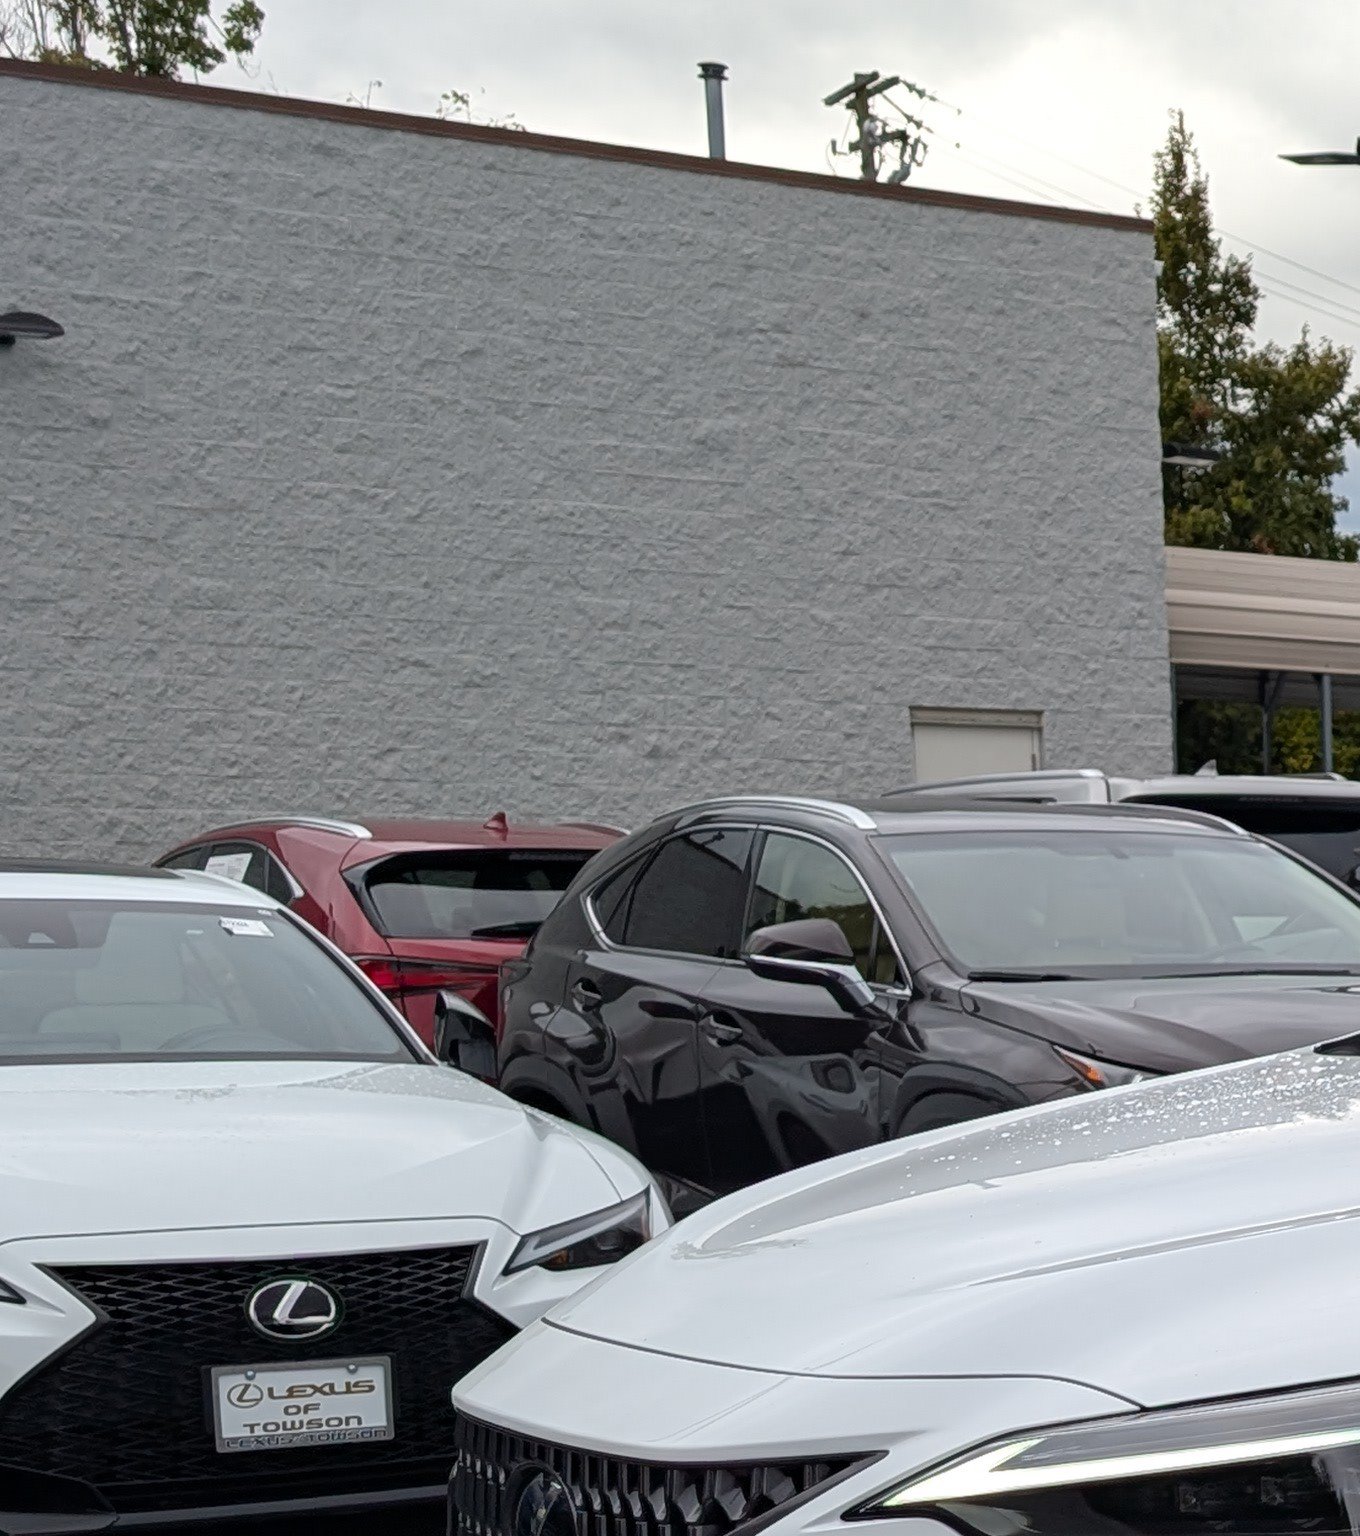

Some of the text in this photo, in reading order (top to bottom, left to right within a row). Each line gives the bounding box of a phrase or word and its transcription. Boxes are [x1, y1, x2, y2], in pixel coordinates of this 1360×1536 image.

[267, 1379, 376, 1399] LEXUS
[283, 1403, 321, 1416] OF
[243, 1415, 363, 1433] TOWSON
